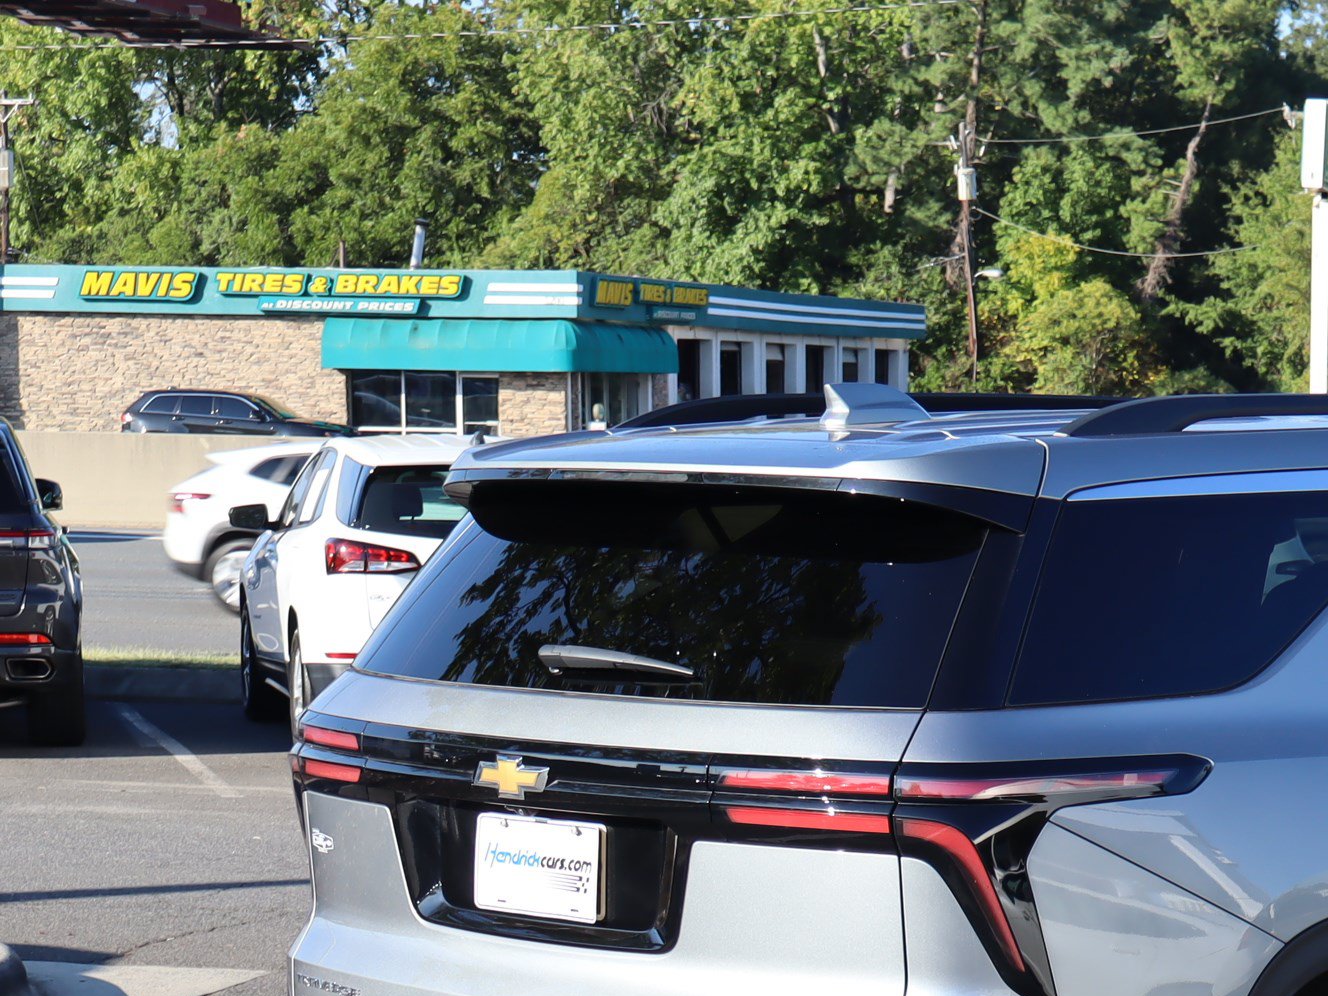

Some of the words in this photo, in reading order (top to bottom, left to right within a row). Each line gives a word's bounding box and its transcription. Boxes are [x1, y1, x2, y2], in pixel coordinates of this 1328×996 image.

[80, 271, 196, 297] MAVIS
[216, 272, 305, 294] TIRES
[309, 276, 330, 294] &
[335, 274, 461, 295] BRAKES
[597, 280, 633, 305] MAVIS
[639, 283, 666, 303] TIRES
[672, 286, 708, 305] BRAKES
[275, 299, 355, 311] DISCOUNT
[357, 301, 415, 312] PRICES
